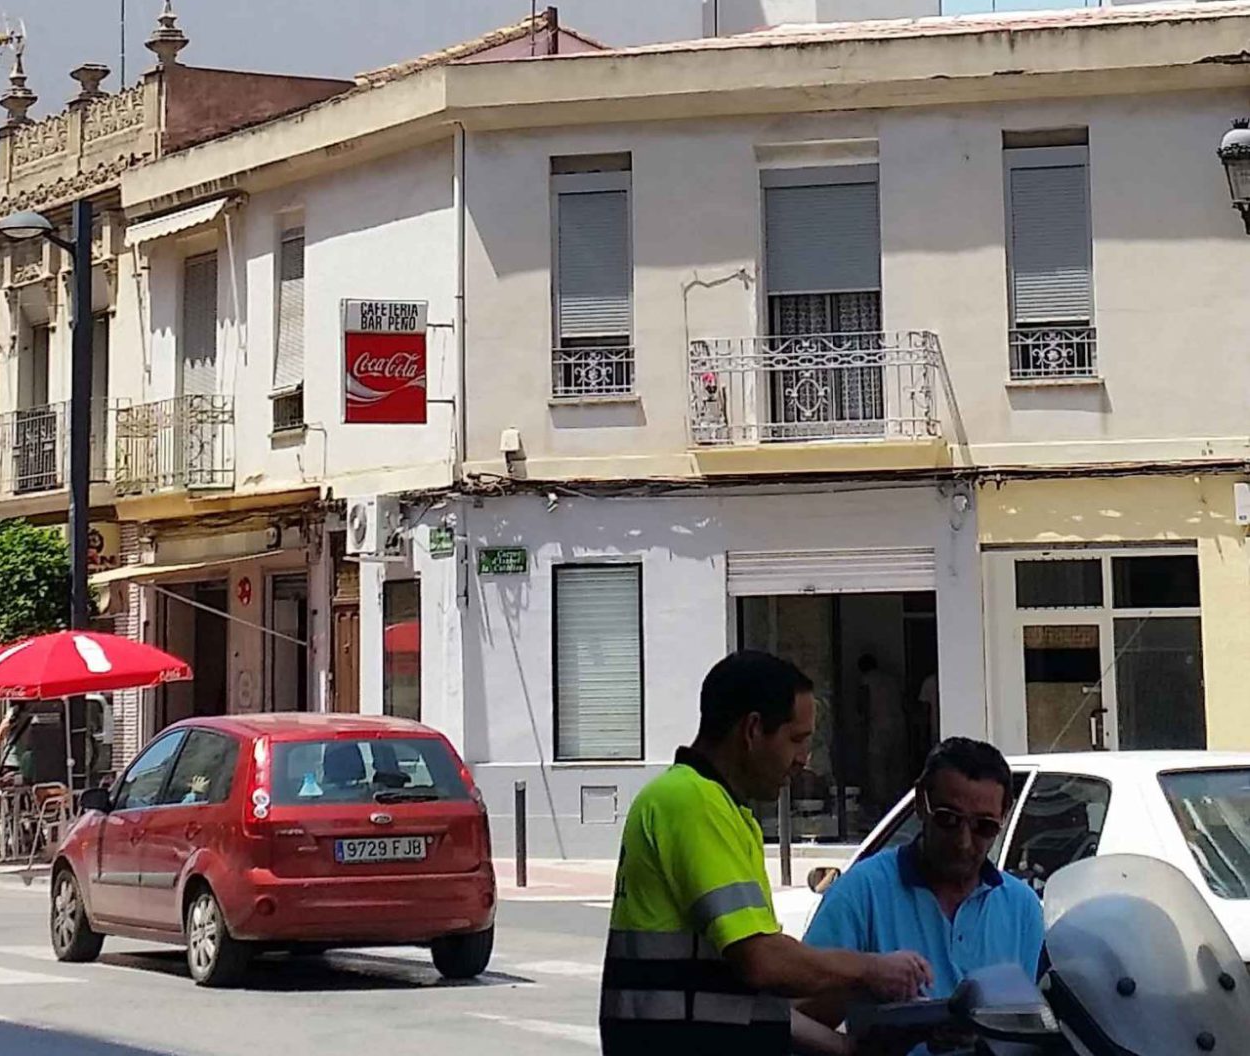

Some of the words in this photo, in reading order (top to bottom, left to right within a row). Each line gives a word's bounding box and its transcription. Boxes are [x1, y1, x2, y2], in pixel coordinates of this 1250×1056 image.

[360, 302, 419, 317] CAFETERIA
[360, 315, 382, 331] BAR
[346, 840, 388, 858] 9729
